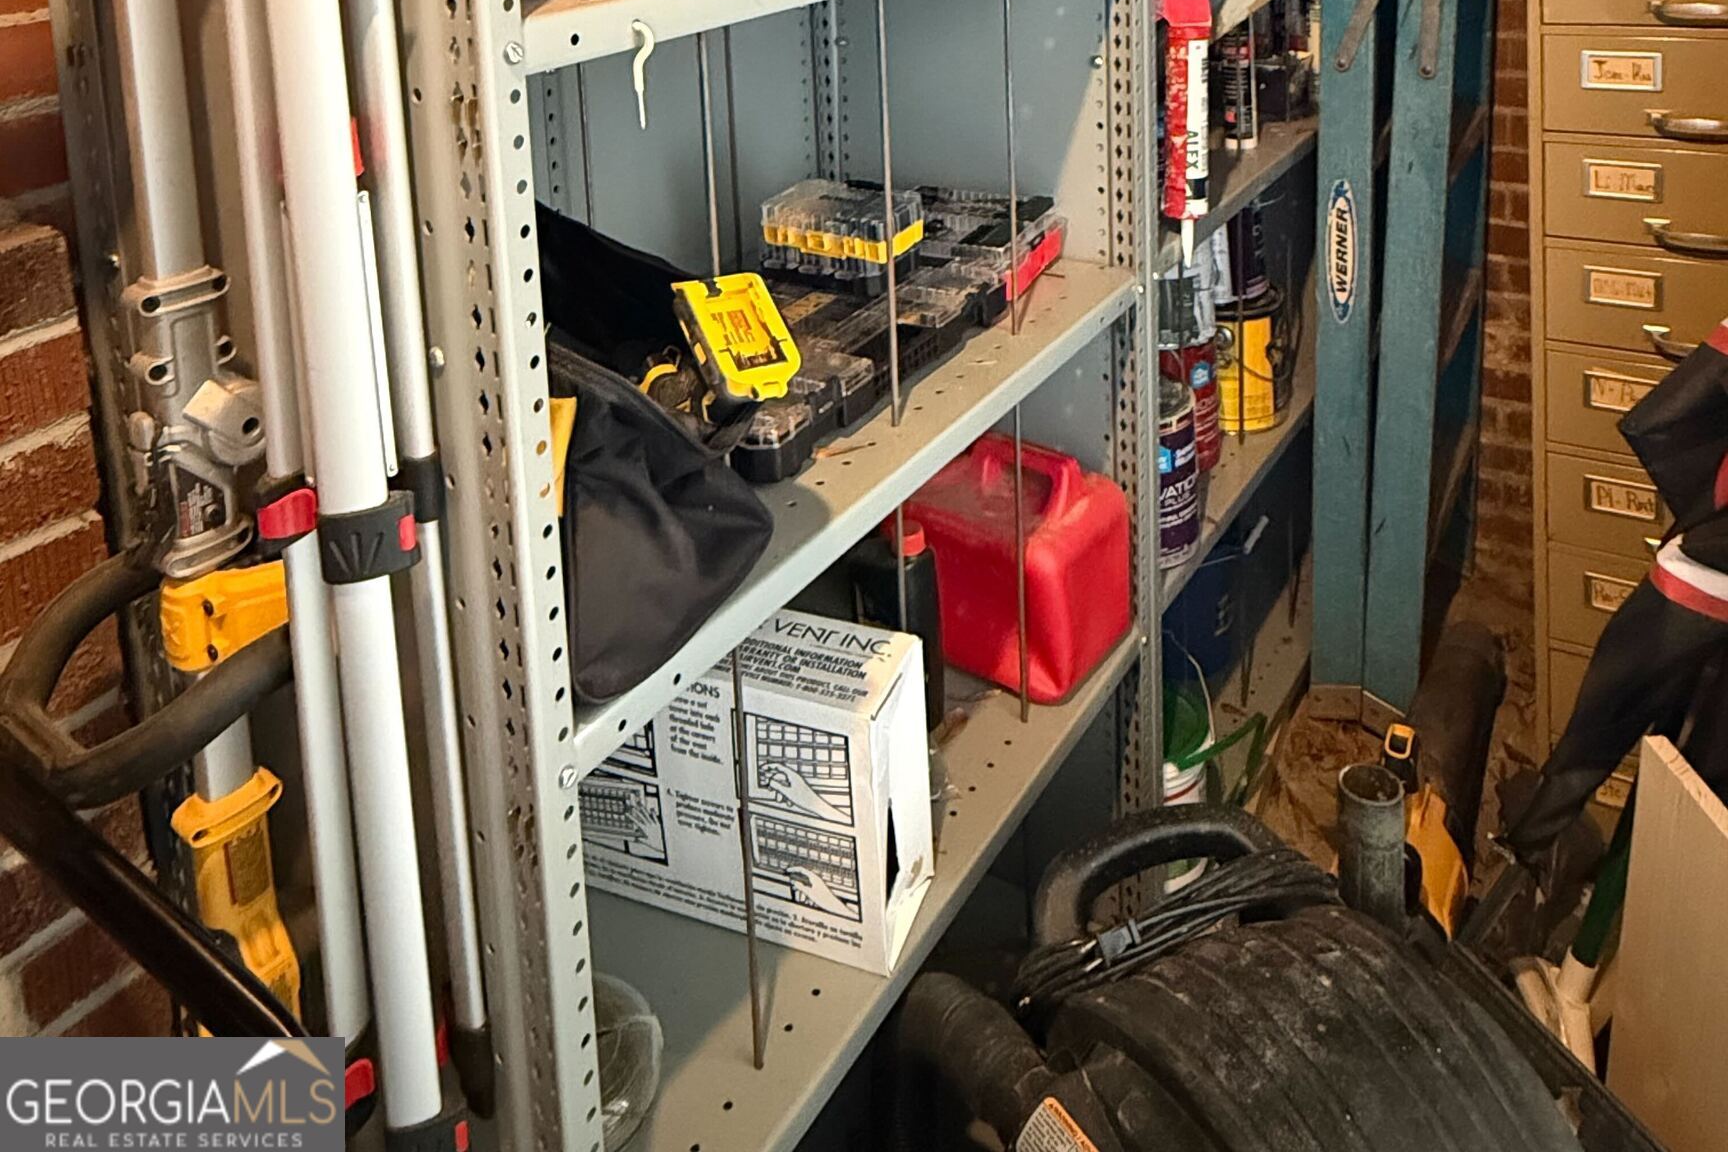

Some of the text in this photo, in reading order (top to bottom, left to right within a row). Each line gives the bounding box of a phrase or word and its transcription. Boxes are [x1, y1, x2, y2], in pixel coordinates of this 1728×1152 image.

[1336, 207, 1348, 293] WERNER
[742, 637, 863, 670] DDITIONAL INFORMATION
[774, 618, 892, 658] VENT INC.
[799, 658, 867, 680] INSTALLATION
